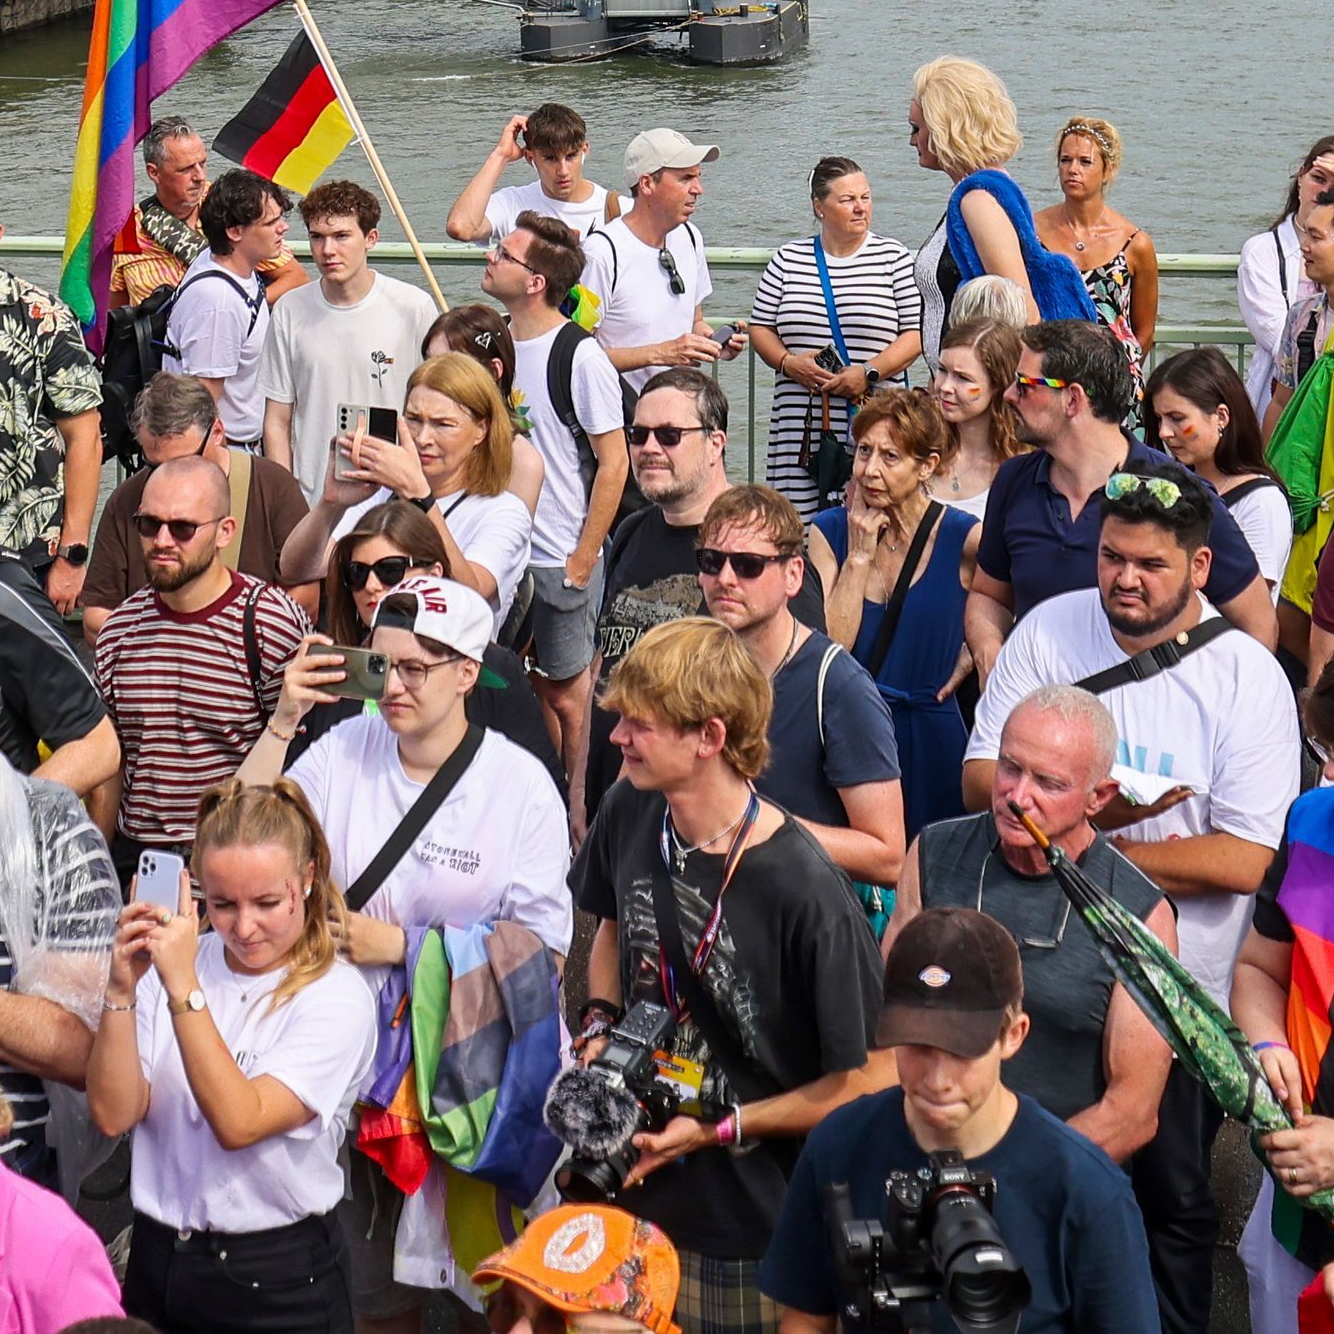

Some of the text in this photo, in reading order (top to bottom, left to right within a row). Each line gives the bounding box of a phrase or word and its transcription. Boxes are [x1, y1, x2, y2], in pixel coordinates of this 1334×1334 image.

[418, 587, 447, 614] AIR
[449, 858, 480, 875] RIOT
[944, 1172, 965, 1181] SONY
